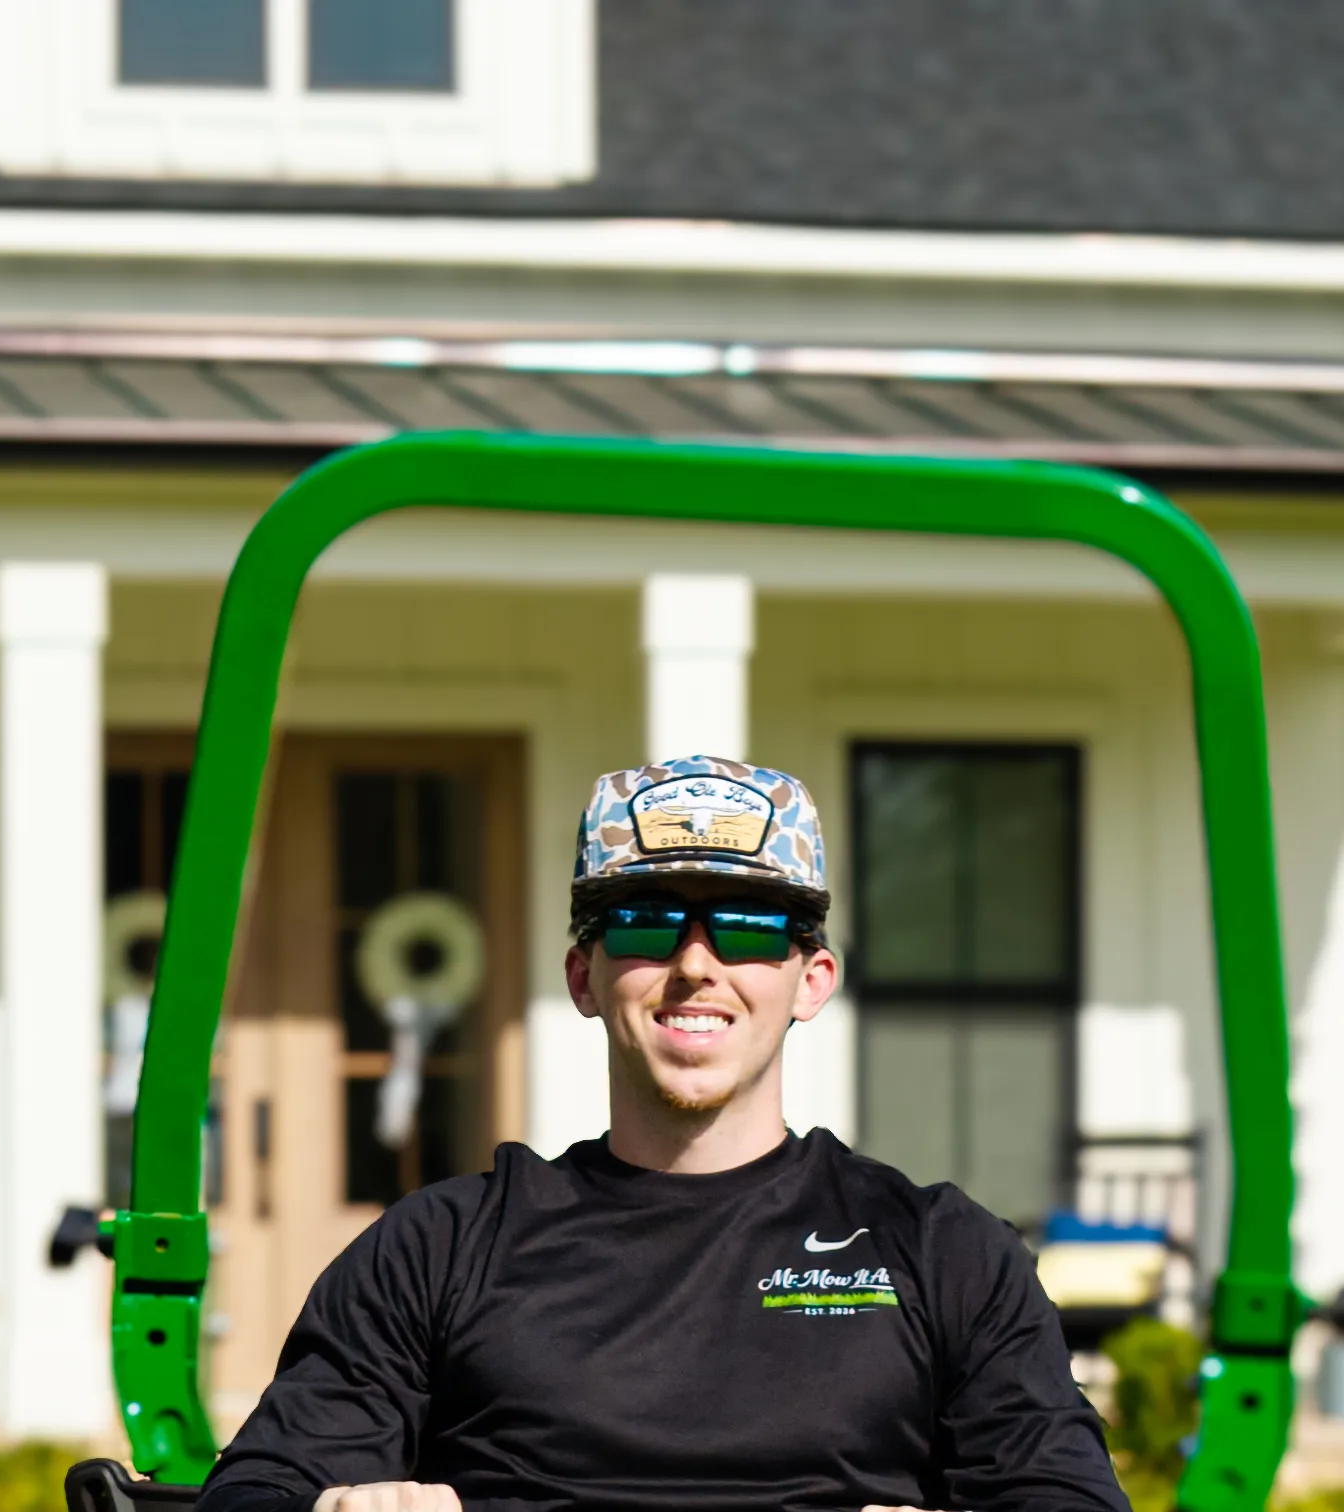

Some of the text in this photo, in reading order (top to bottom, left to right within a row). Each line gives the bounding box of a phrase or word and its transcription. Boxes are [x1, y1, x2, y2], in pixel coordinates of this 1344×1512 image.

[643, 781, 763, 811] Good Ole Boys
[660, 835, 740, 847] OUTDOORS
[758, 1268, 799, 1291] Mr.
[797, 1268, 852, 1290] Mow
